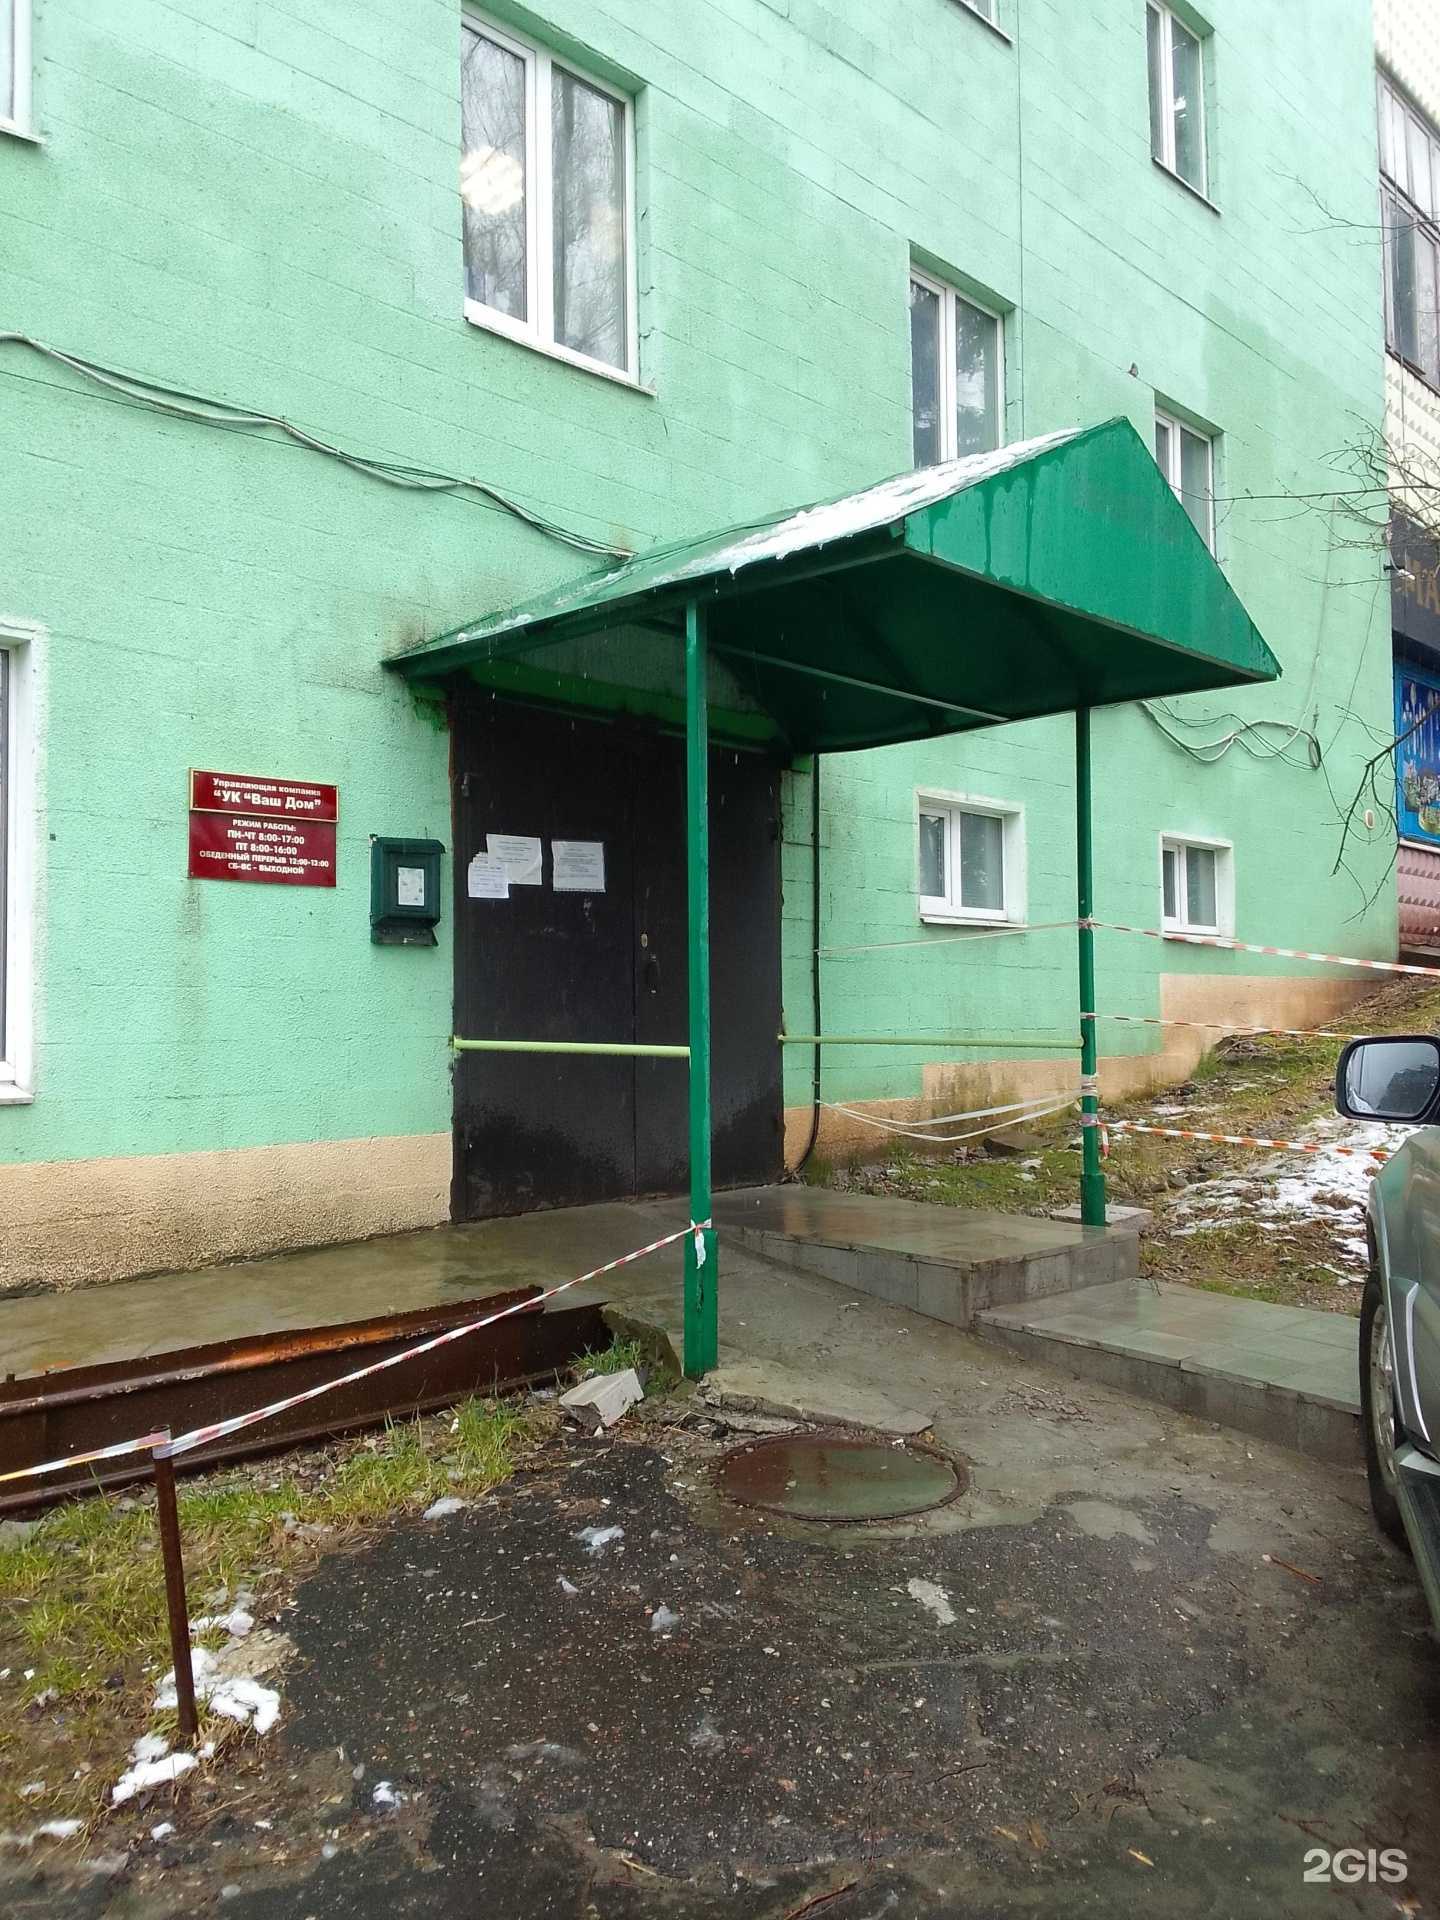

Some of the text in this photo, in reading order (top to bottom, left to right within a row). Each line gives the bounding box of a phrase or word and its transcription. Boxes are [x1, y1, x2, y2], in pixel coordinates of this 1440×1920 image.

[213, 778, 321, 797] Управляющая компания
[233, 819, 296, 832] РЕЖИМ РАБОТЫ:
[227, 830, 305, 845] ПН-ЧТ 8:00-17:00
[235, 842, 297, 855] ПТ 8:00-16:00
[199, 850, 250, 862] ОБЕДЕННЫЙ
[252, 854, 287, 864] ПЕРЕРЫВ
[259, 865, 304, 875] ВЫХОДНОЙ
